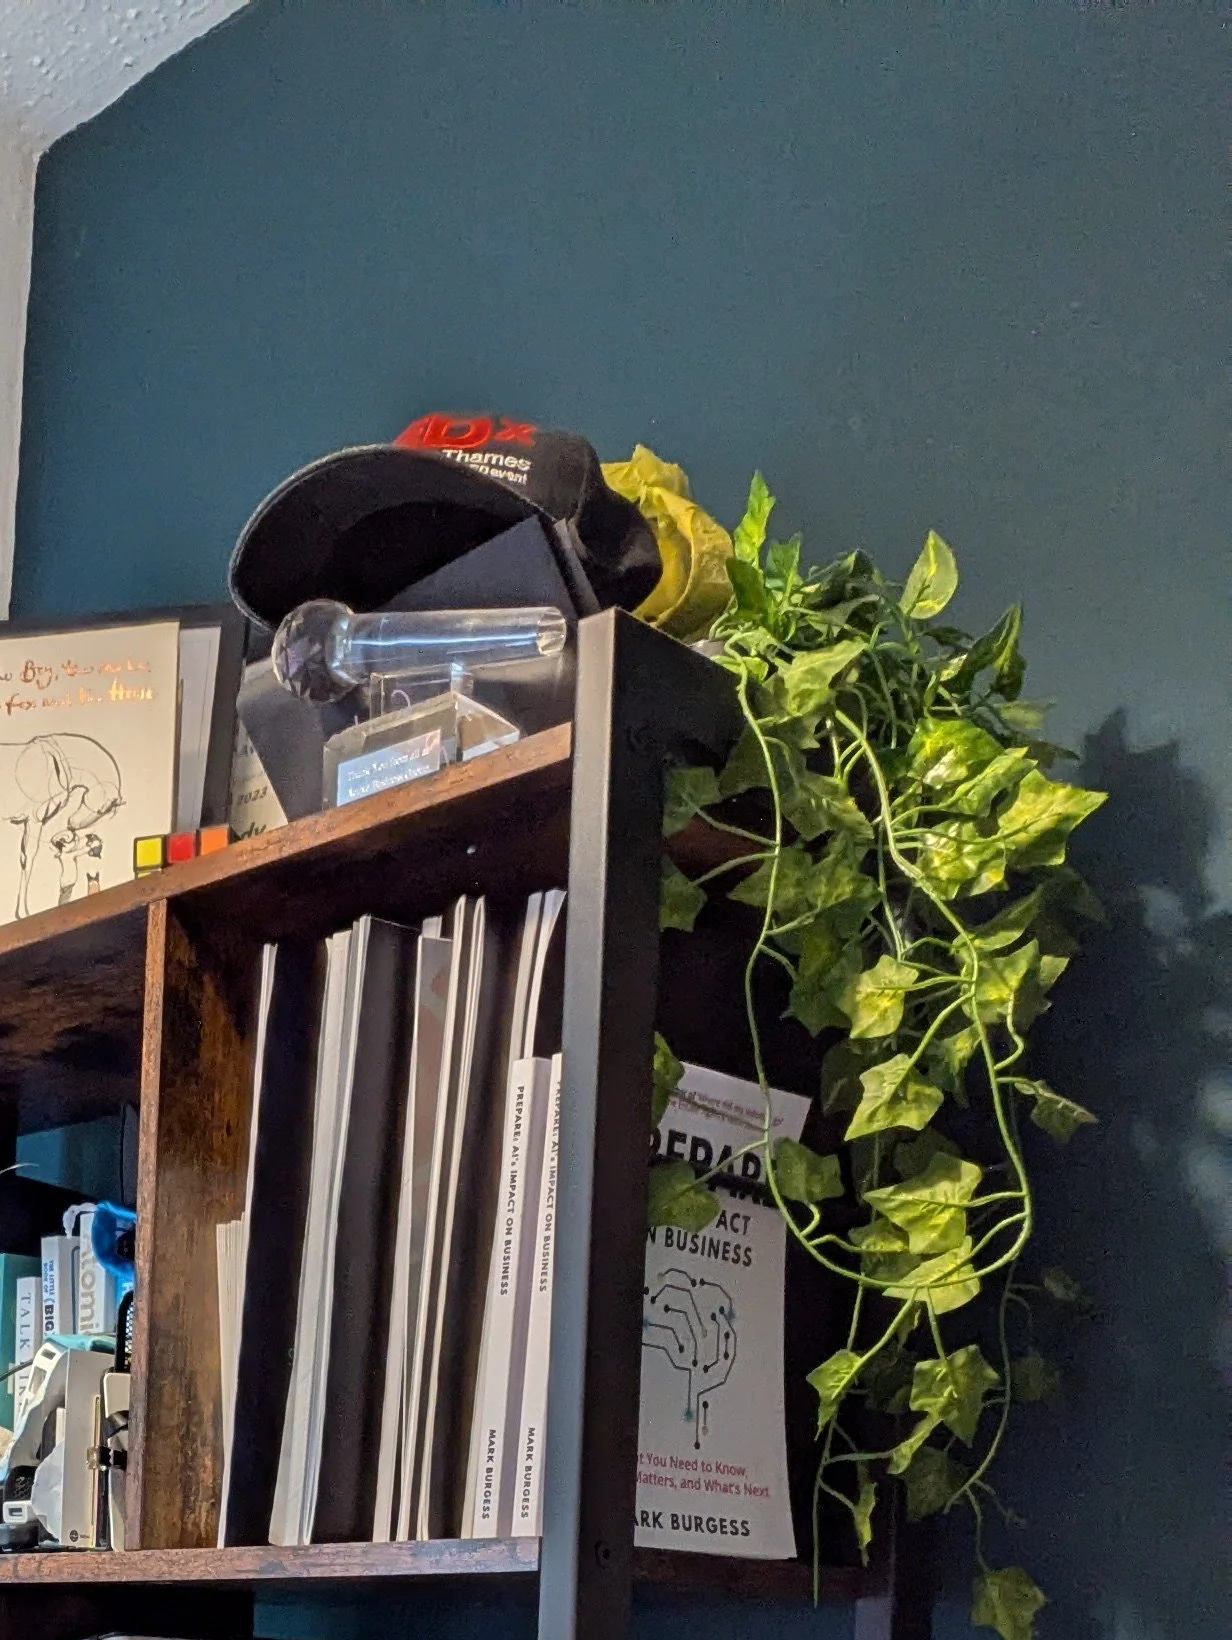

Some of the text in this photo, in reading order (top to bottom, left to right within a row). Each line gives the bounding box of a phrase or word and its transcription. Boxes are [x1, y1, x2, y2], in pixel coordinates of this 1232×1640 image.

[441, 449, 531, 472] Thames
[514, 1086, 525, 1142] PREPARE:
[507, 1169, 518, 1214] IMPACT
[546, 1163, 558, 1209] IMPACT
[505, 1217, 514, 1236] ON
[544, 1213, 554, 1232] ON
[500, 1240, 513, 1297] BUSINESS
[539, 1235, 552, 1293] BUSINESS
[664, 1227, 753, 1267] BUSINESS
[19, 1292, 31, 1350] TALK
[482, 1429, 497, 1520] MARK BURGESS
[521, 1427, 536, 1519] MARK BURGESS
[647, 1452, 667, 1468] You
[670, 1455, 699, 1472] Need
[702, 1460, 713, 1472] to
[680, 1476, 741, 1496] and What's
[670, 1512, 751, 1537] BURGESS
